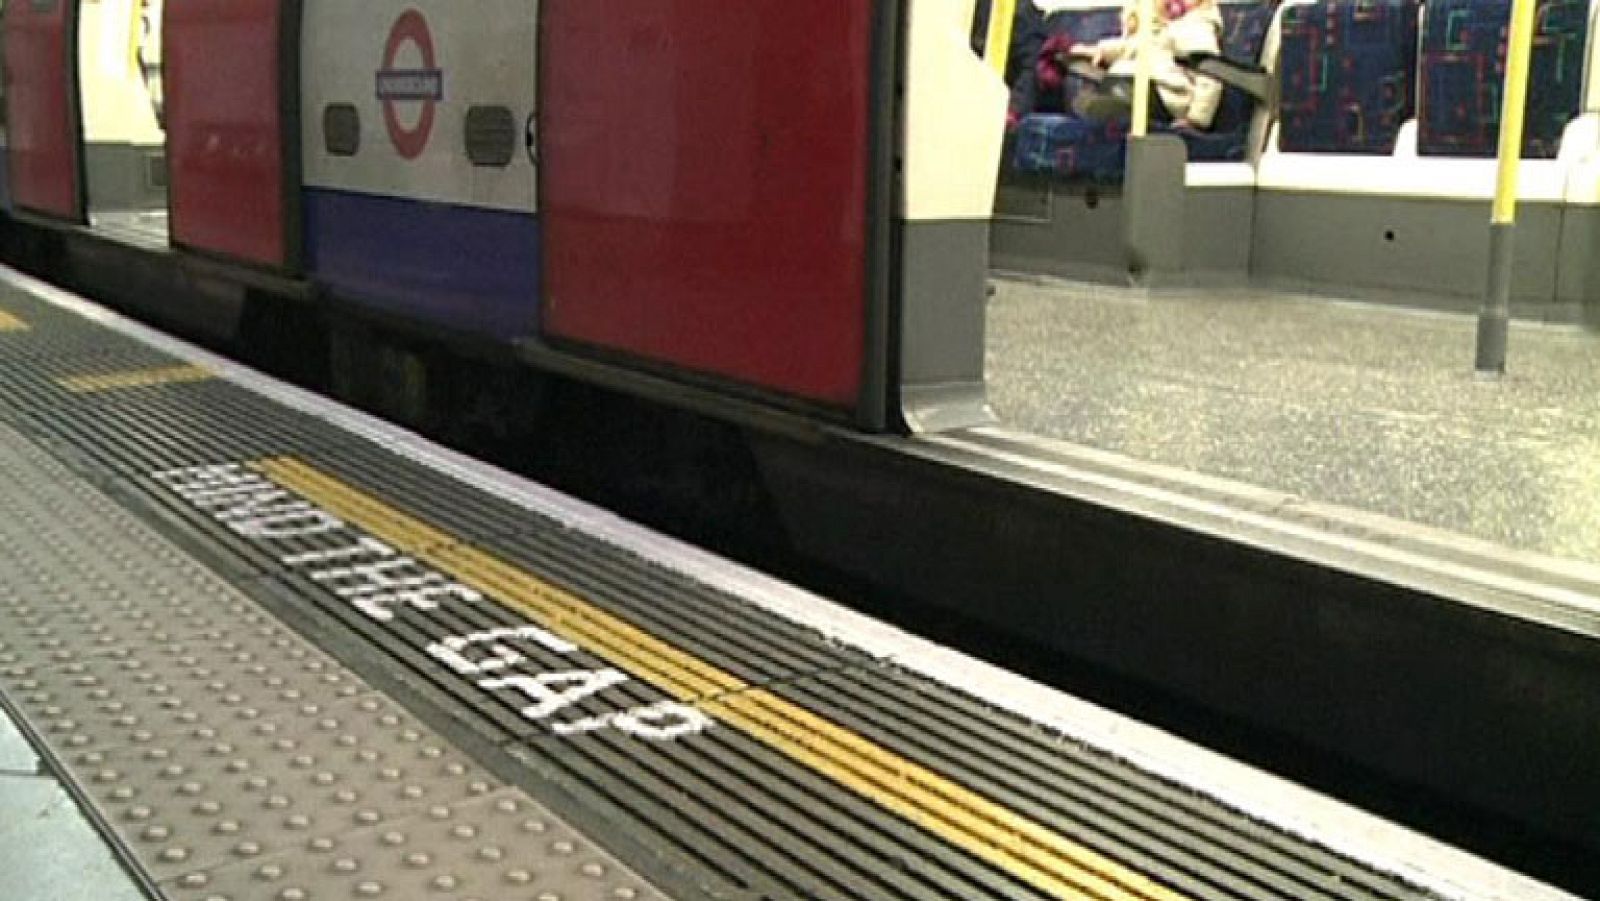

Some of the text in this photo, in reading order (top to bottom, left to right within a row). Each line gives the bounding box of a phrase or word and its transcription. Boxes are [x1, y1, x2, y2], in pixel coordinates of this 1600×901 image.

[152, 462, 714, 740] MIND THE GAP
